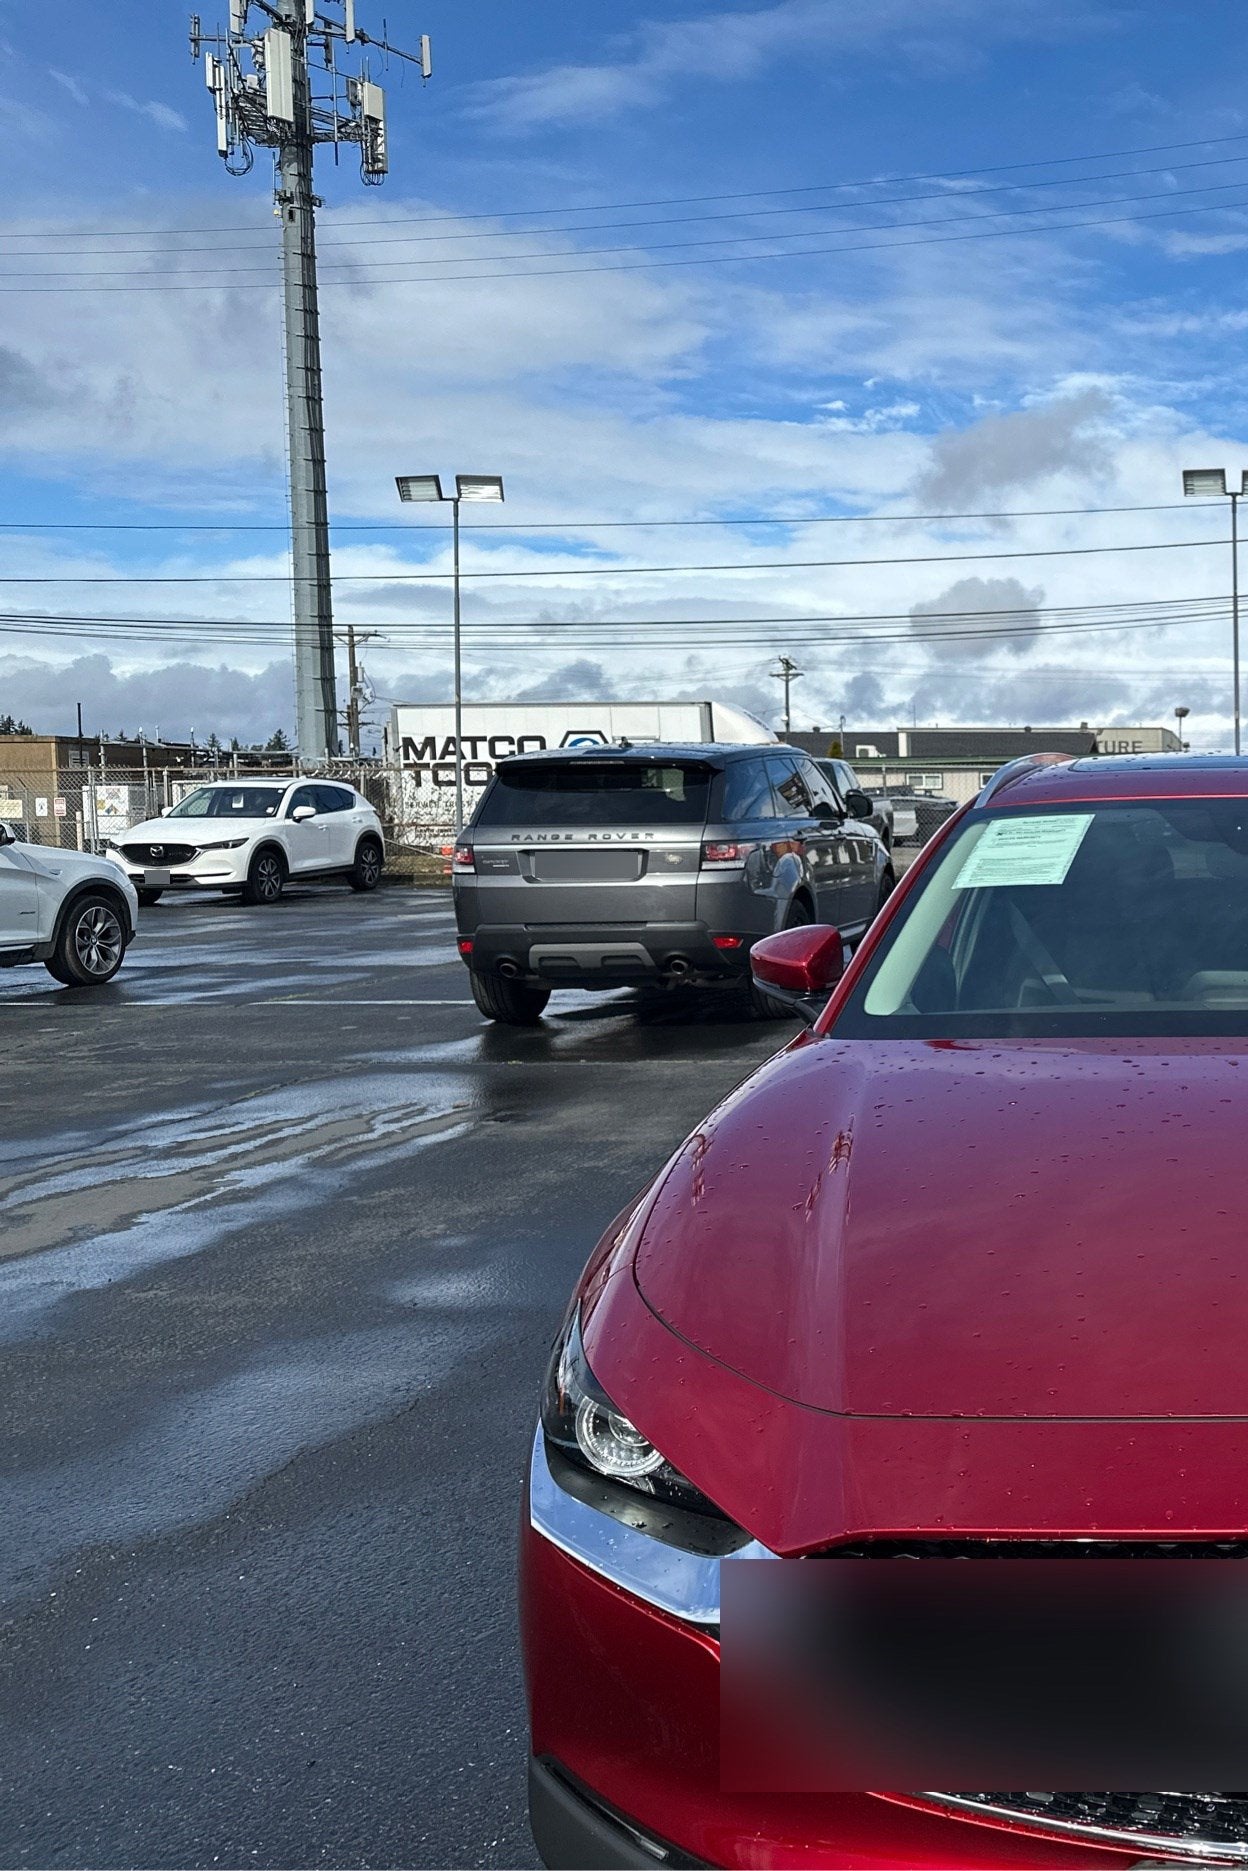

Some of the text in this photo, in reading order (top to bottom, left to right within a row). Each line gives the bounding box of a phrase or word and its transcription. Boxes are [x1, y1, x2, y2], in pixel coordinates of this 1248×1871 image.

[401, 735, 547, 761] MATCO
[402, 761, 497, 788] TOO
[511, 832, 655, 841] RANGE ROVER
